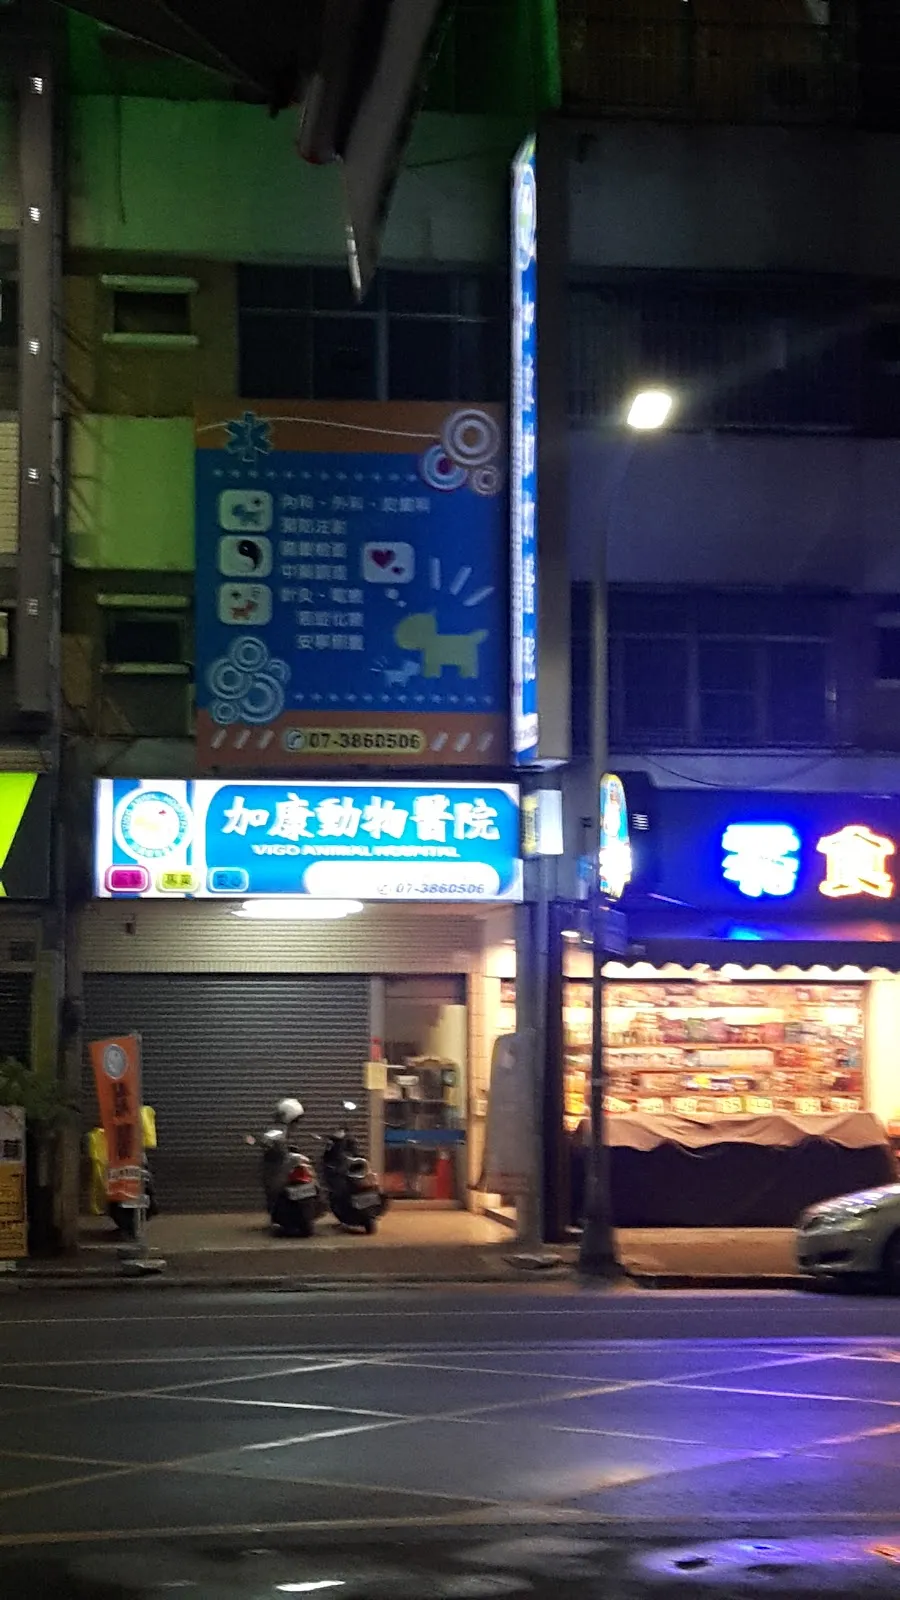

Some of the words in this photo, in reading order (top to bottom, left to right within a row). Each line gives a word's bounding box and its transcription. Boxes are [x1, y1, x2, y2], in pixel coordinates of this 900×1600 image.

[309, 732, 421, 749] 07-3860506
[221, 792, 500, 843] 加康動物醫院
[251, 844, 301, 856] VIGO
[302, 845, 373, 857] ANIMAL
[396, 883, 485, 895] 07-3860506
